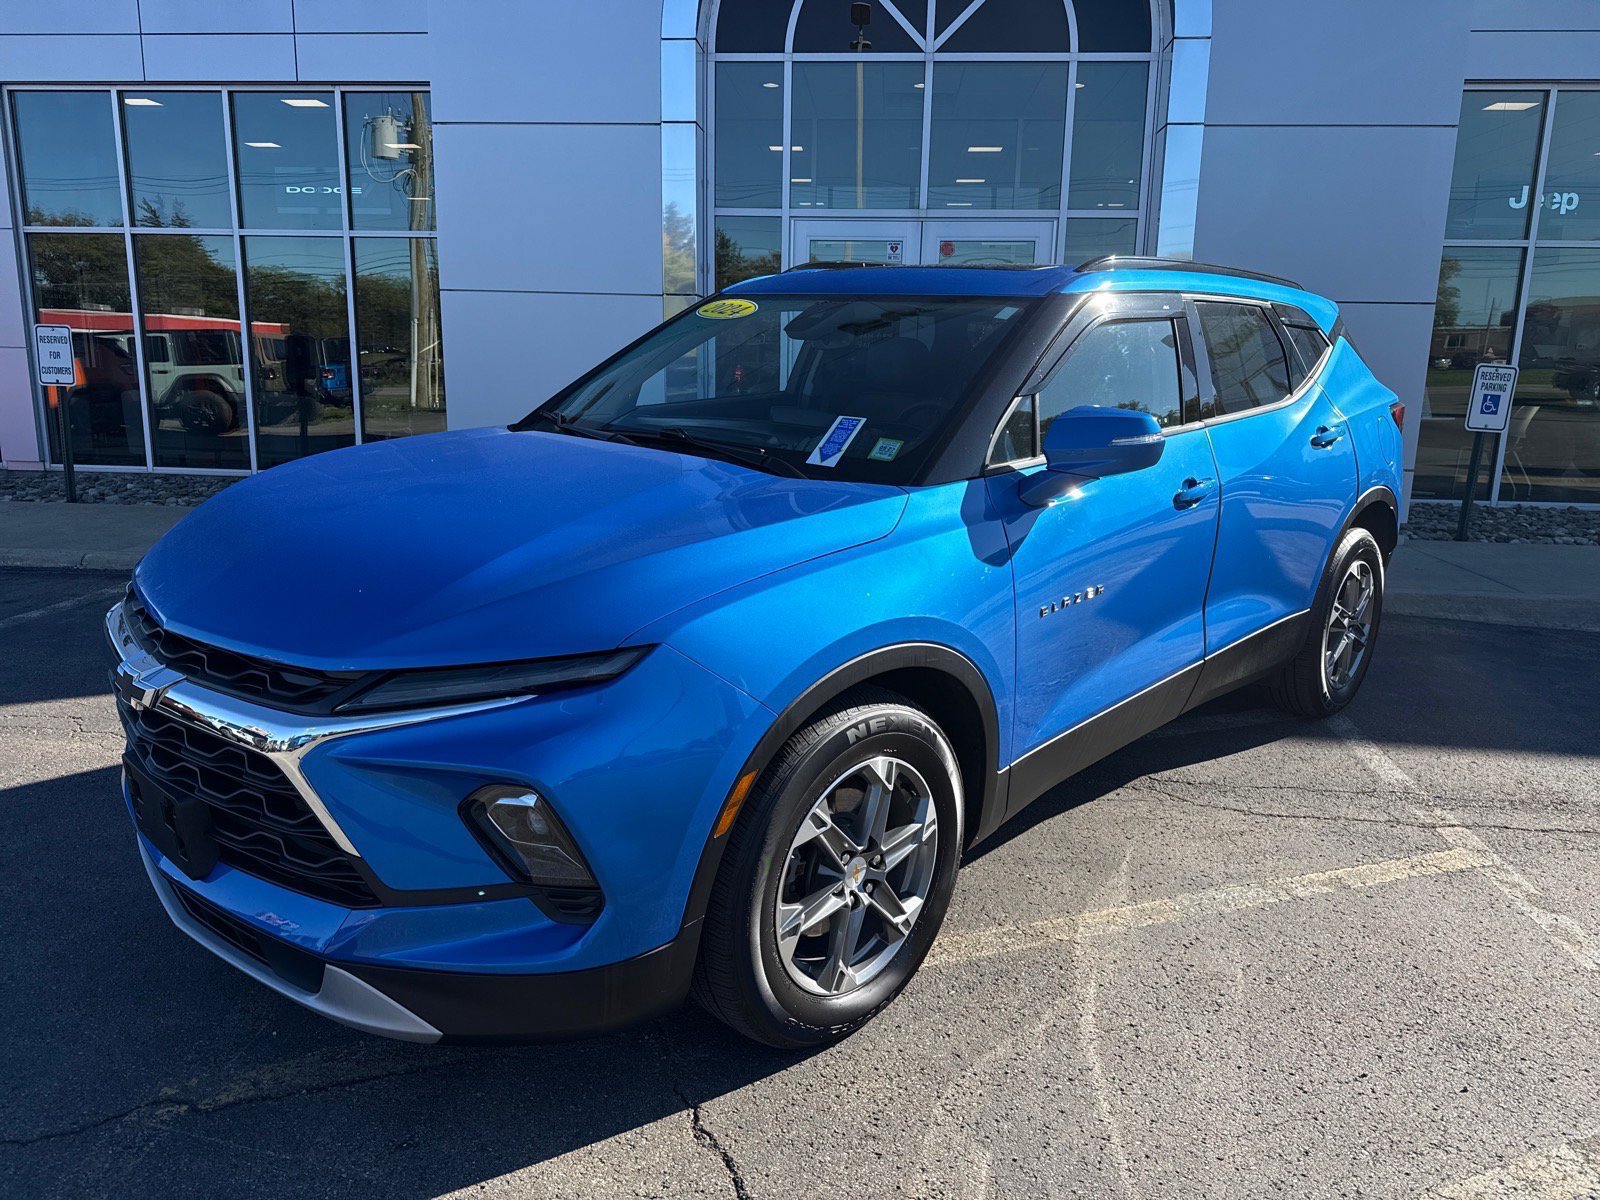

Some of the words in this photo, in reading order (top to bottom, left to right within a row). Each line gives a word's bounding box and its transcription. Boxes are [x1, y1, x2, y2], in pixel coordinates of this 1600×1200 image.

[39, 336, 69, 344] RESERVED
[49, 351, 61, 359] FOR
[41, 366, 72, 375] CUSTOMERS
[1480, 371, 1512, 383] RESERVED
[1480, 382, 1508, 393] PARKING
[845, 715, 939, 746] NEXEN
